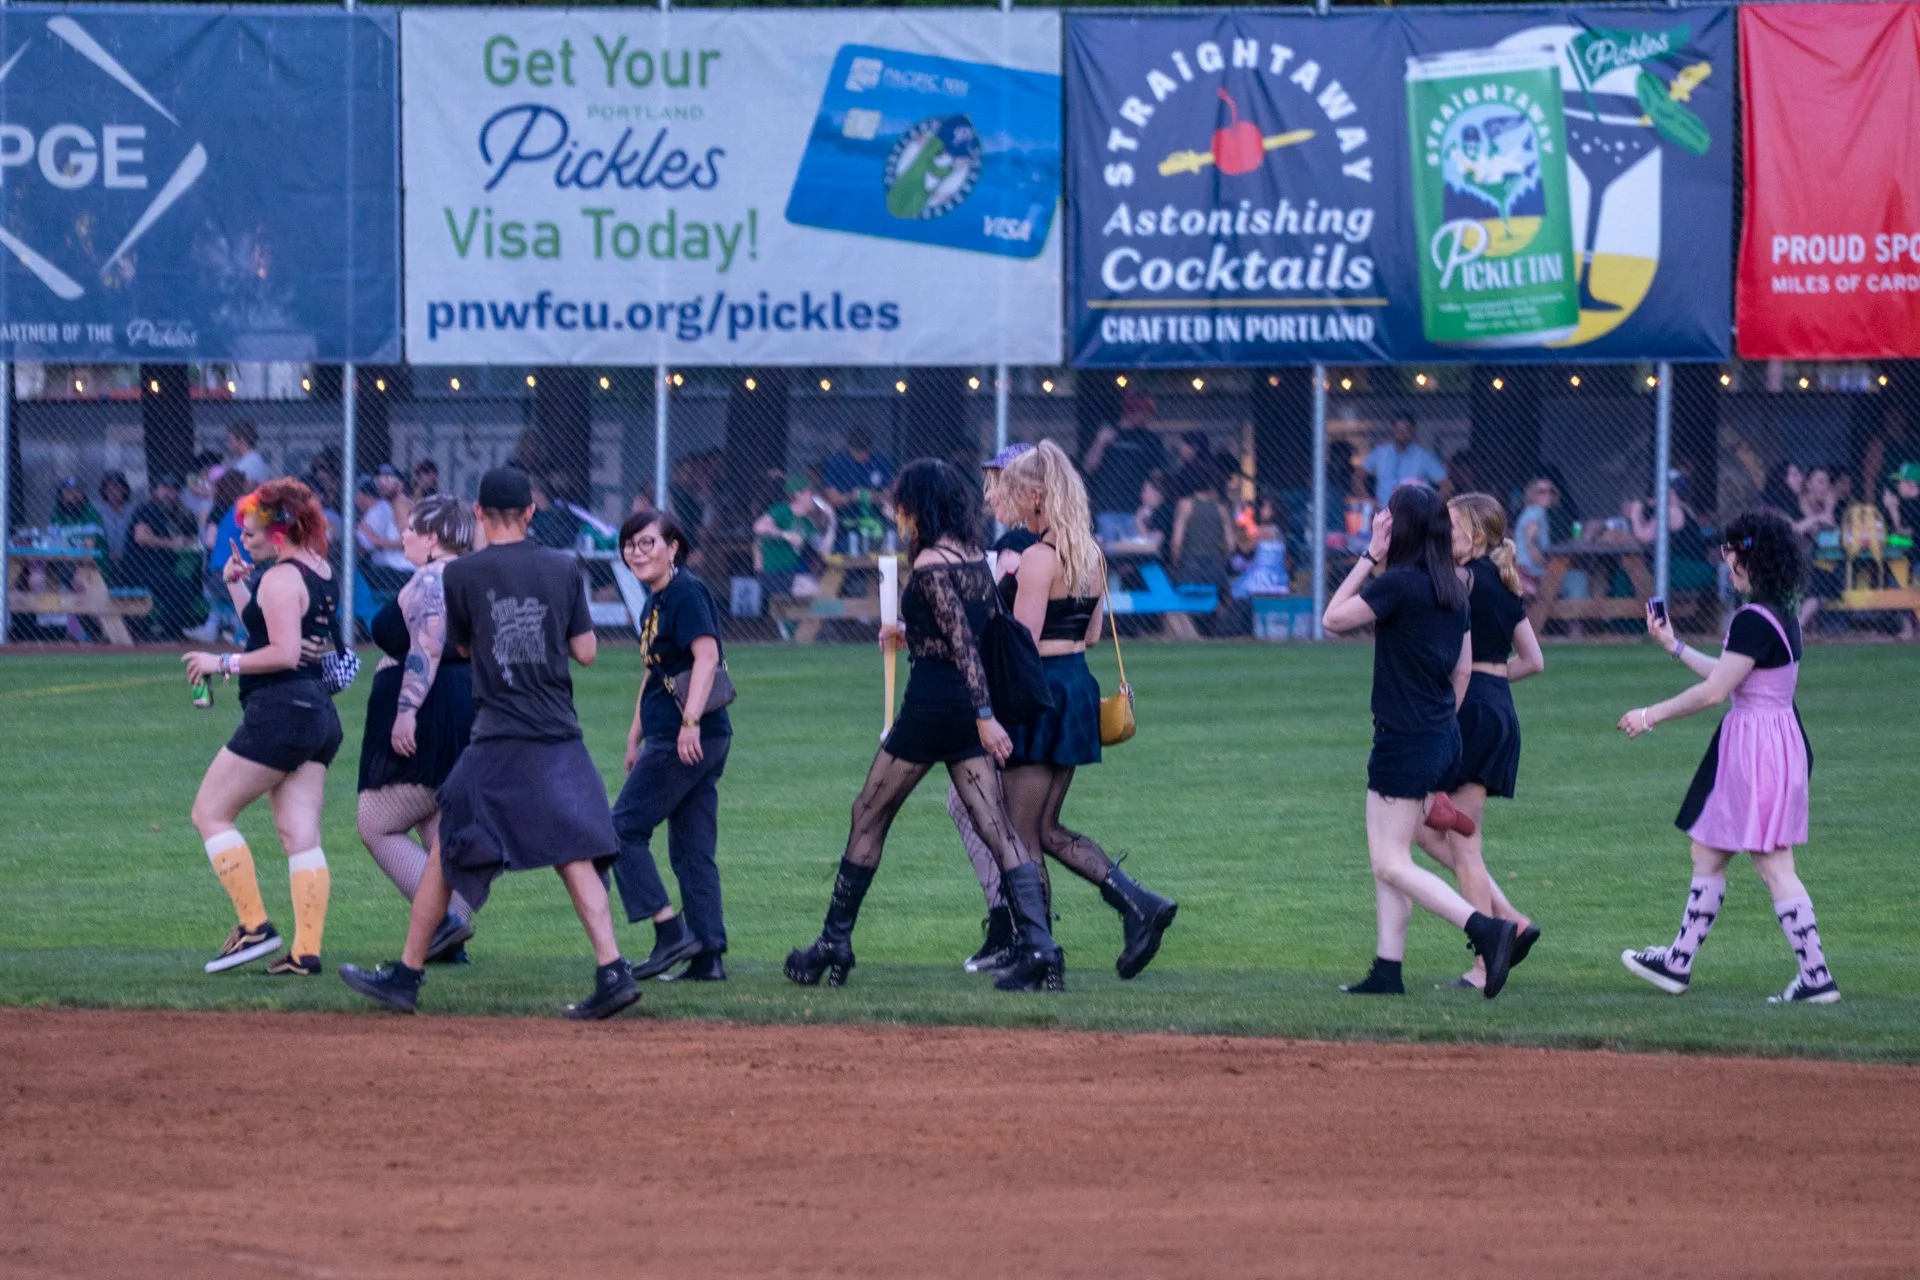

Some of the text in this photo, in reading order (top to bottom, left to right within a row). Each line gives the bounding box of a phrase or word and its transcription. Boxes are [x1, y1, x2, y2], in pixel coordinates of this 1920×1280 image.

[483, 34, 721, 88] Get Your
[587, 105, 703, 120] PORTLAND
[1104, 38, 1373, 187] STRAIGHTAWAY
[0, 123, 148, 189] PGE
[478, 103, 726, 193] Pickles
[444, 207, 758, 274] Visa Today!
[983, 215, 1034, 242] VISA
[1102, 199, 1375, 242] Astonishing
[1102, 244, 1374, 292] Cocktails
[1771, 234, 1866, 265] PROUD
[1771, 275, 1830, 293] MILES
[1834, 274, 1861, 292] OF
[62, 323, 81, 342] OF
[86, 323, 114, 343] THE
[427, 290, 901, 342] pnwfcu.org/pickles
[1102, 314, 1375, 344] CRAFTED IN PORTLAND
